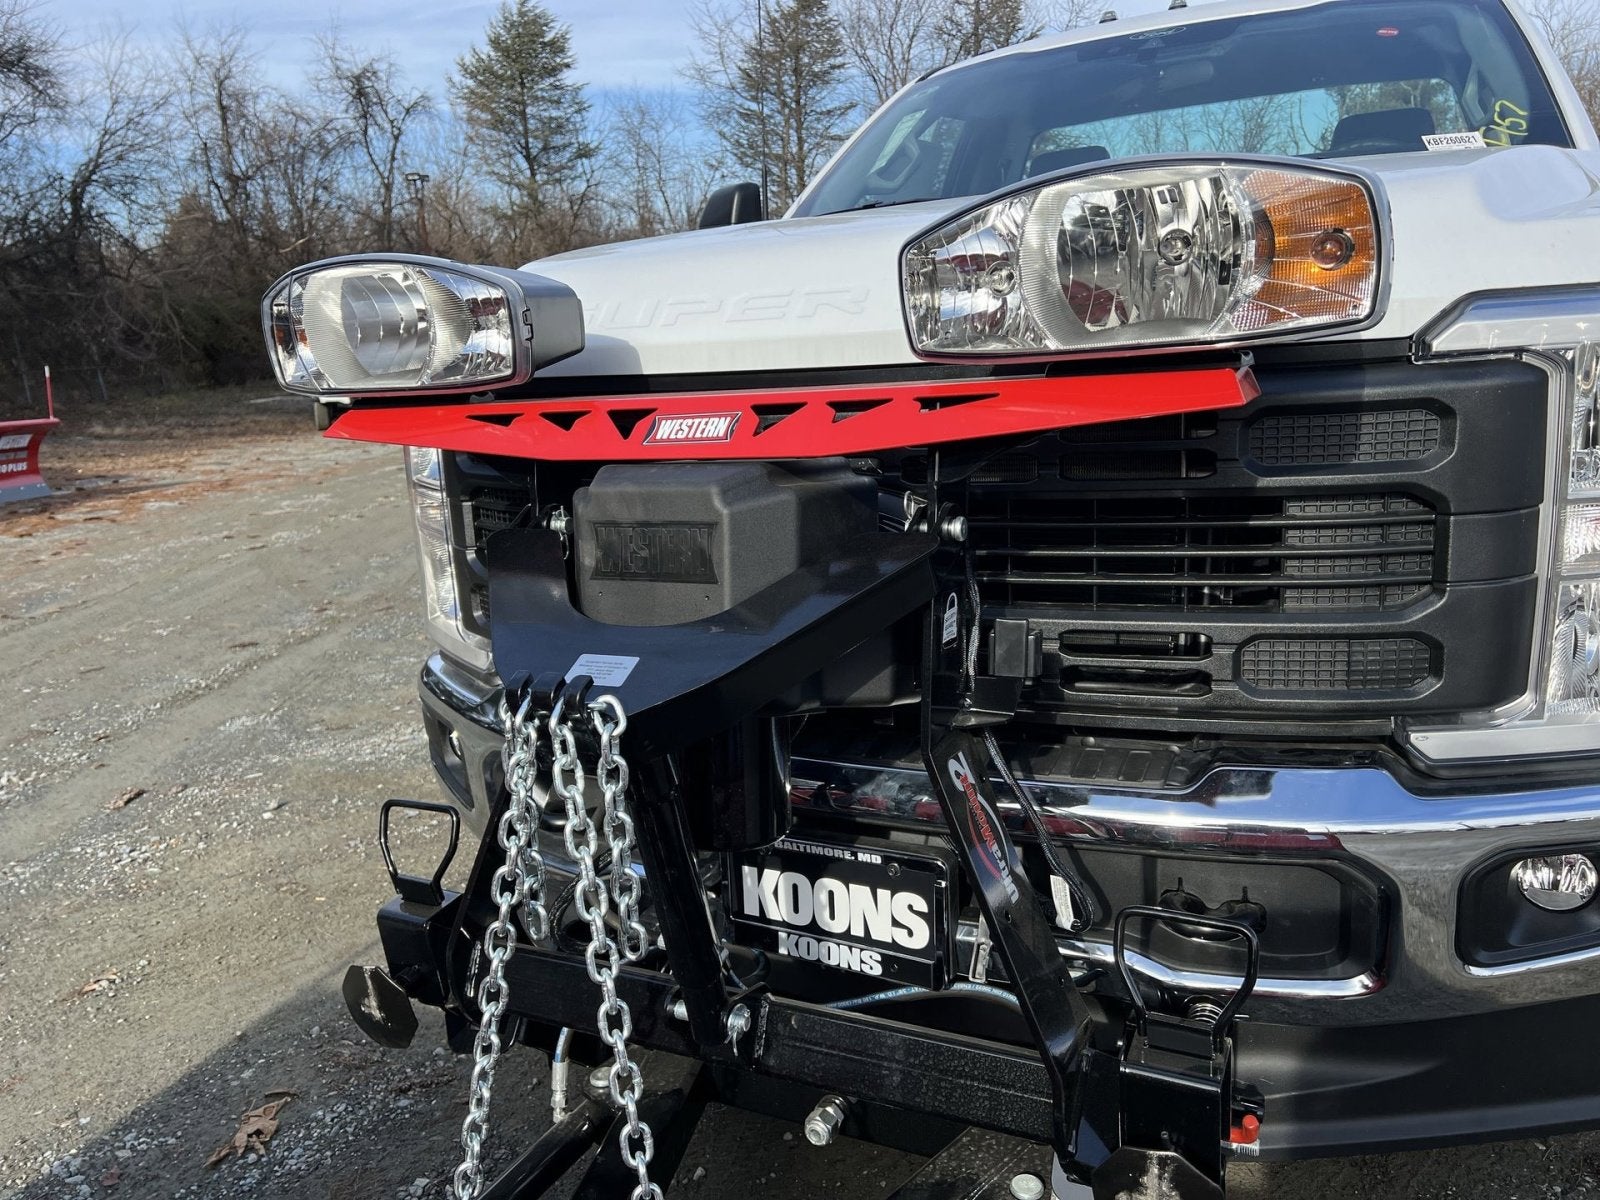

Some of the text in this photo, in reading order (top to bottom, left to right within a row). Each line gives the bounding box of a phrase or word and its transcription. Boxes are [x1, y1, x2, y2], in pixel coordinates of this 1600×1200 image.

[584, 288, 870, 330] UPER
[655, 416, 731, 439] WESTERN
[8, 462, 28, 473] PLUS
[597, 527, 710, 574] WESTERN
[948, 751, 976, 792] 2
[858, 852, 882, 865] MD
[741, 865, 930, 950] KOONS
[778, 931, 882, 976] KOONS
